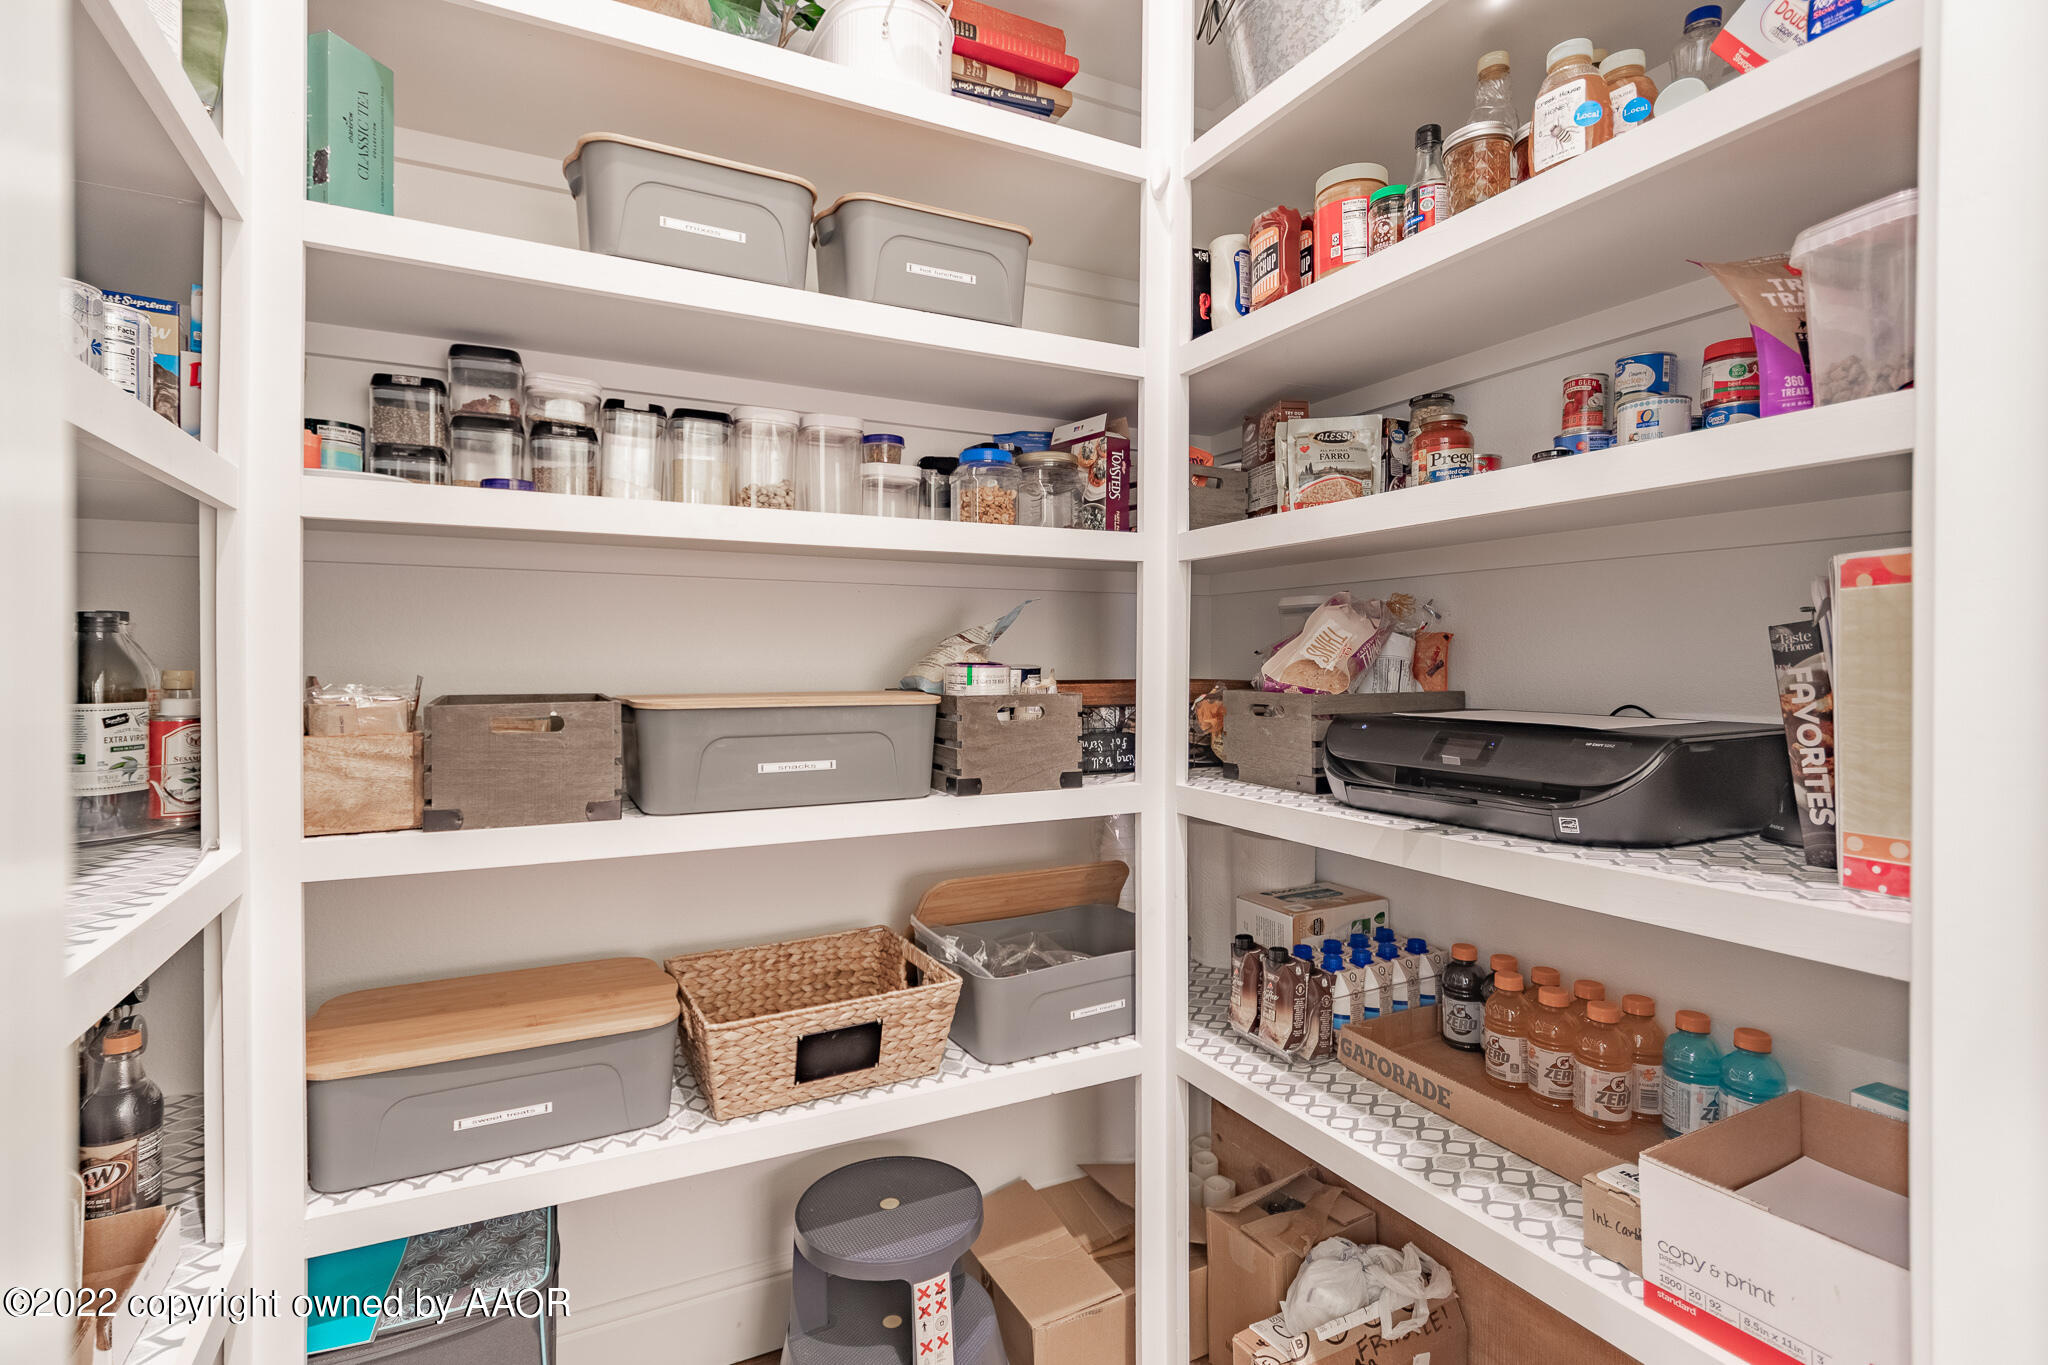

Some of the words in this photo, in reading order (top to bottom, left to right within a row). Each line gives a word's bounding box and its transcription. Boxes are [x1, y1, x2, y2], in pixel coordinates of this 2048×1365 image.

[1774, 1, 1808, 33] Doub
[1810, 21, 1822, 34] 4
[357, 90, 369, 118] TEA
[1623, 104, 1649, 117] Local
[1576, 109, 1600, 121] Local
[357, 119, 369, 181] CLASSIC
[121, 296, 173, 312] Supreme
[1784, 375, 1805, 387] 360
[1781, 386, 1810, 398] TREATS
[1317, 431, 1354, 441] ALESSI
[1319, 452, 1351, 461] FARRO
[1430, 452, 1473, 468] Prego
[1305, 625, 1349, 664] THINS
[1776, 631, 1812, 645] Taste
[1784, 641, 1814, 653] Home
[103, 734, 128, 744] EXTRA
[1082, 740, 1103, 753] Servi
[1788, 667, 1836, 826] FAVORITES
[172, 754, 200, 763] SESAM
[777, 762, 817, 771] snacks
[1092, 757, 1113, 769] Bell
[1447, 1014, 1478, 1031] ZERO
[1486, 1047, 1511, 1064] ERO
[1340, 1037, 1451, 1109] GATORADE
[1700, 1106, 1721, 1122] ZE
[1592, 1208, 1613, 1229] Ink
[1658, 1252, 1683, 1269] paper
[1657, 1240, 1707, 1273] copy
[1709, 1264, 1721, 1279] &
[1724, 1270, 1776, 1308] print
[1656, 1290, 1698, 1317] standard
[1659, 1273, 1683, 1292] 1500
[1688, 1288, 1702, 1302] 20
[1708, 1299, 1722, 1313] 92
[1743, 1317, 1770, 1338] 8.5in
[1771, 1333, 1779, 1343] x
[1781, 1337, 1805, 1356] 11in
